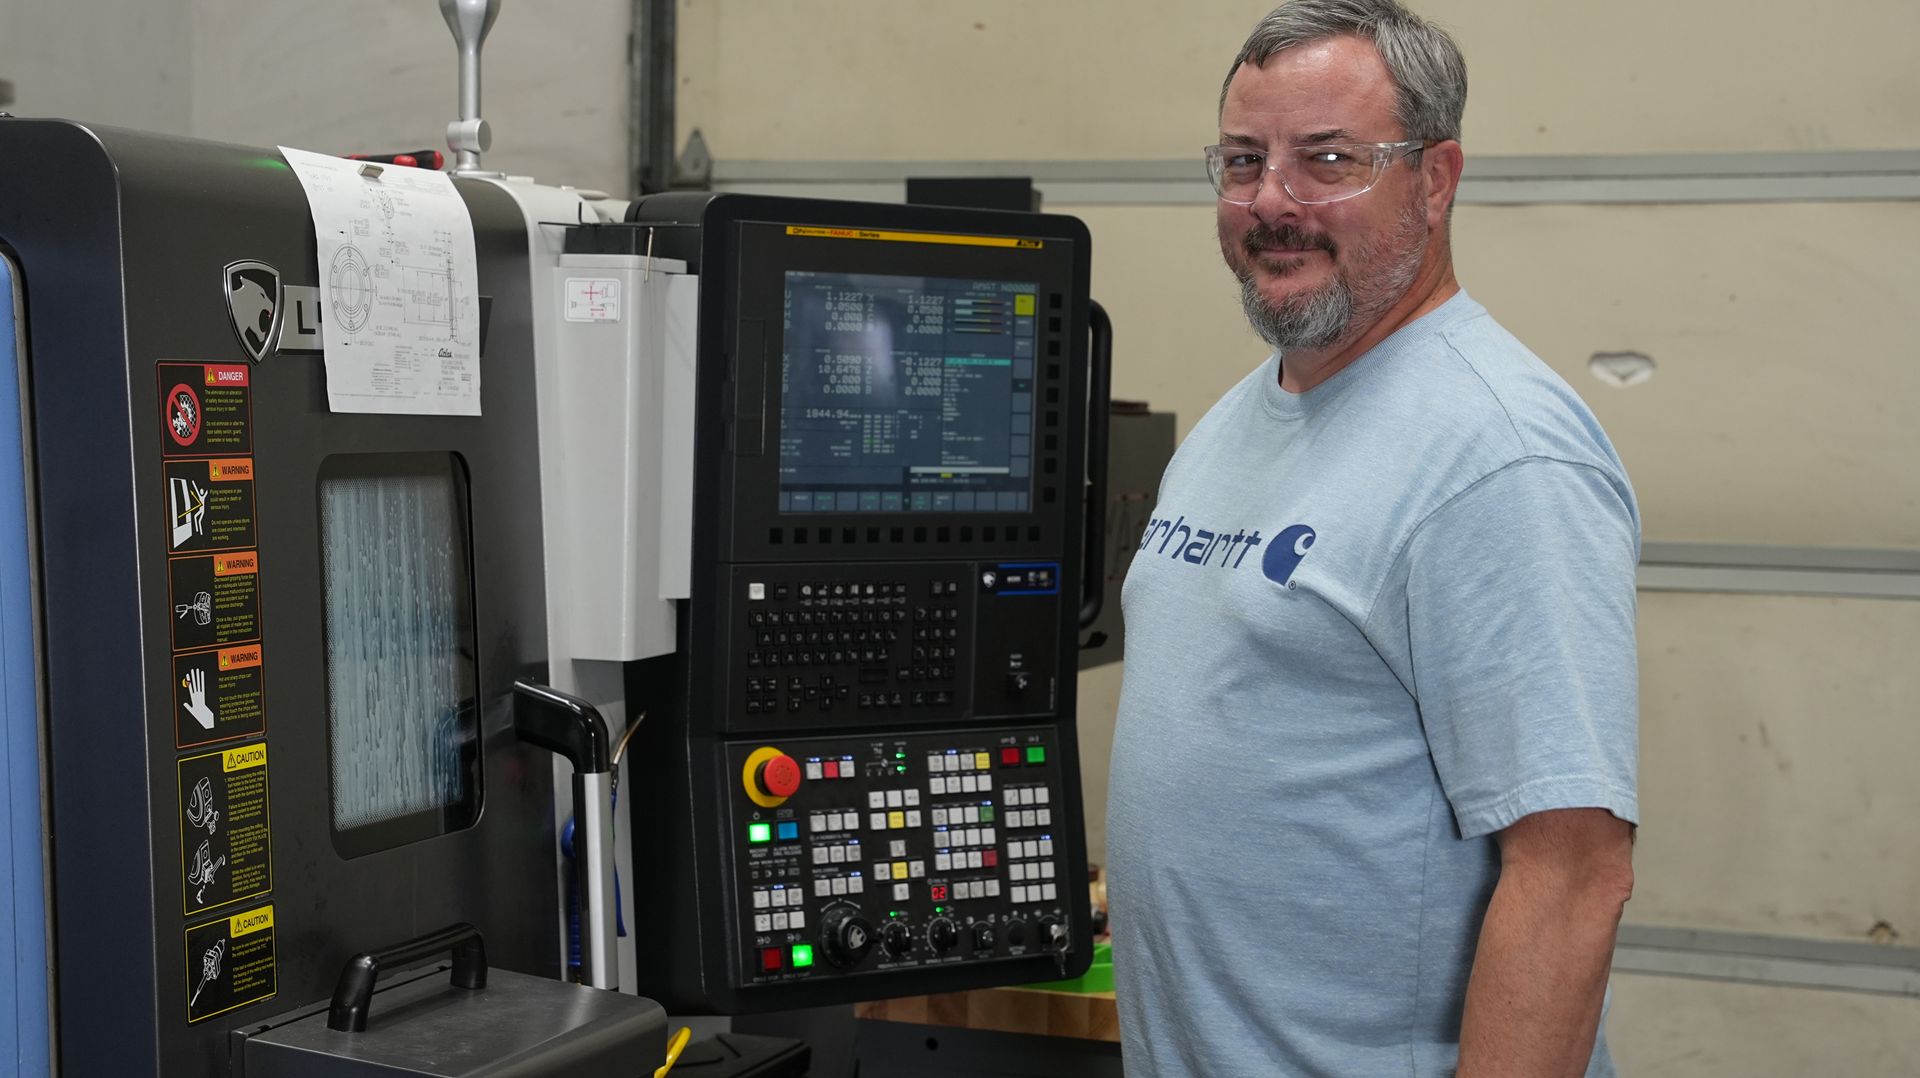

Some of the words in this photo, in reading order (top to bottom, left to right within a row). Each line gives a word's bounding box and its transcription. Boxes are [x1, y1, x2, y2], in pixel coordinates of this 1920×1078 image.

[826, 292, 863, 301] 1.1227
[908, 296, 944, 304] 1.1227
[826, 302, 863, 311] 0.0500
[218, 371, 244, 381] DANGER
[806, 408, 849, 418] 1844.94
[222, 466, 249, 475] WARNING
[226, 558, 254, 569] WARNING
[230, 652, 258, 664] WARNING
[236, 750, 264, 764] CAUTION
[931, 886, 946, 900] 02
[243, 914, 269, 929] CAUTION
